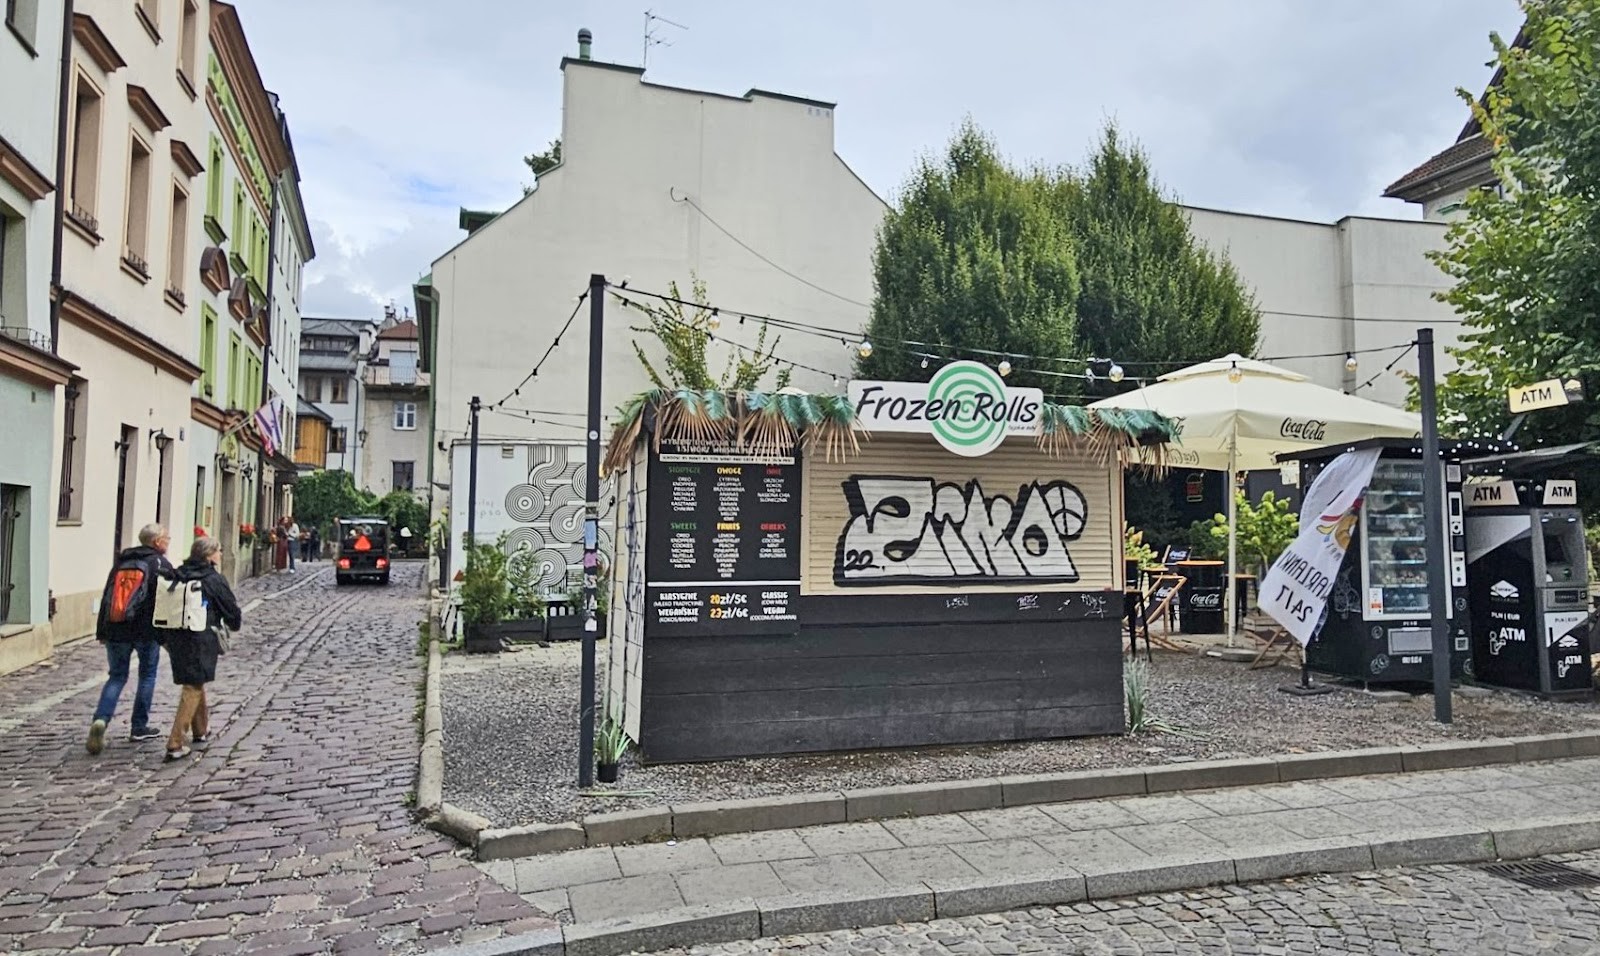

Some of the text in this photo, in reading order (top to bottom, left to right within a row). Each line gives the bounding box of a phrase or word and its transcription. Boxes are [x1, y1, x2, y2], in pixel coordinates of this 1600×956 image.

[1521, 388, 1552, 405] ATM
[855, 386, 1039, 423] Frozen Rolls
[1473, 486, 1501, 500] ATM
[1552, 486, 1572, 497] ATM
[710, 608, 748, 619] 23zł/6€
[1499, 627, 1526, 641] ATM
[1565, 655, 1582, 664] ATM
